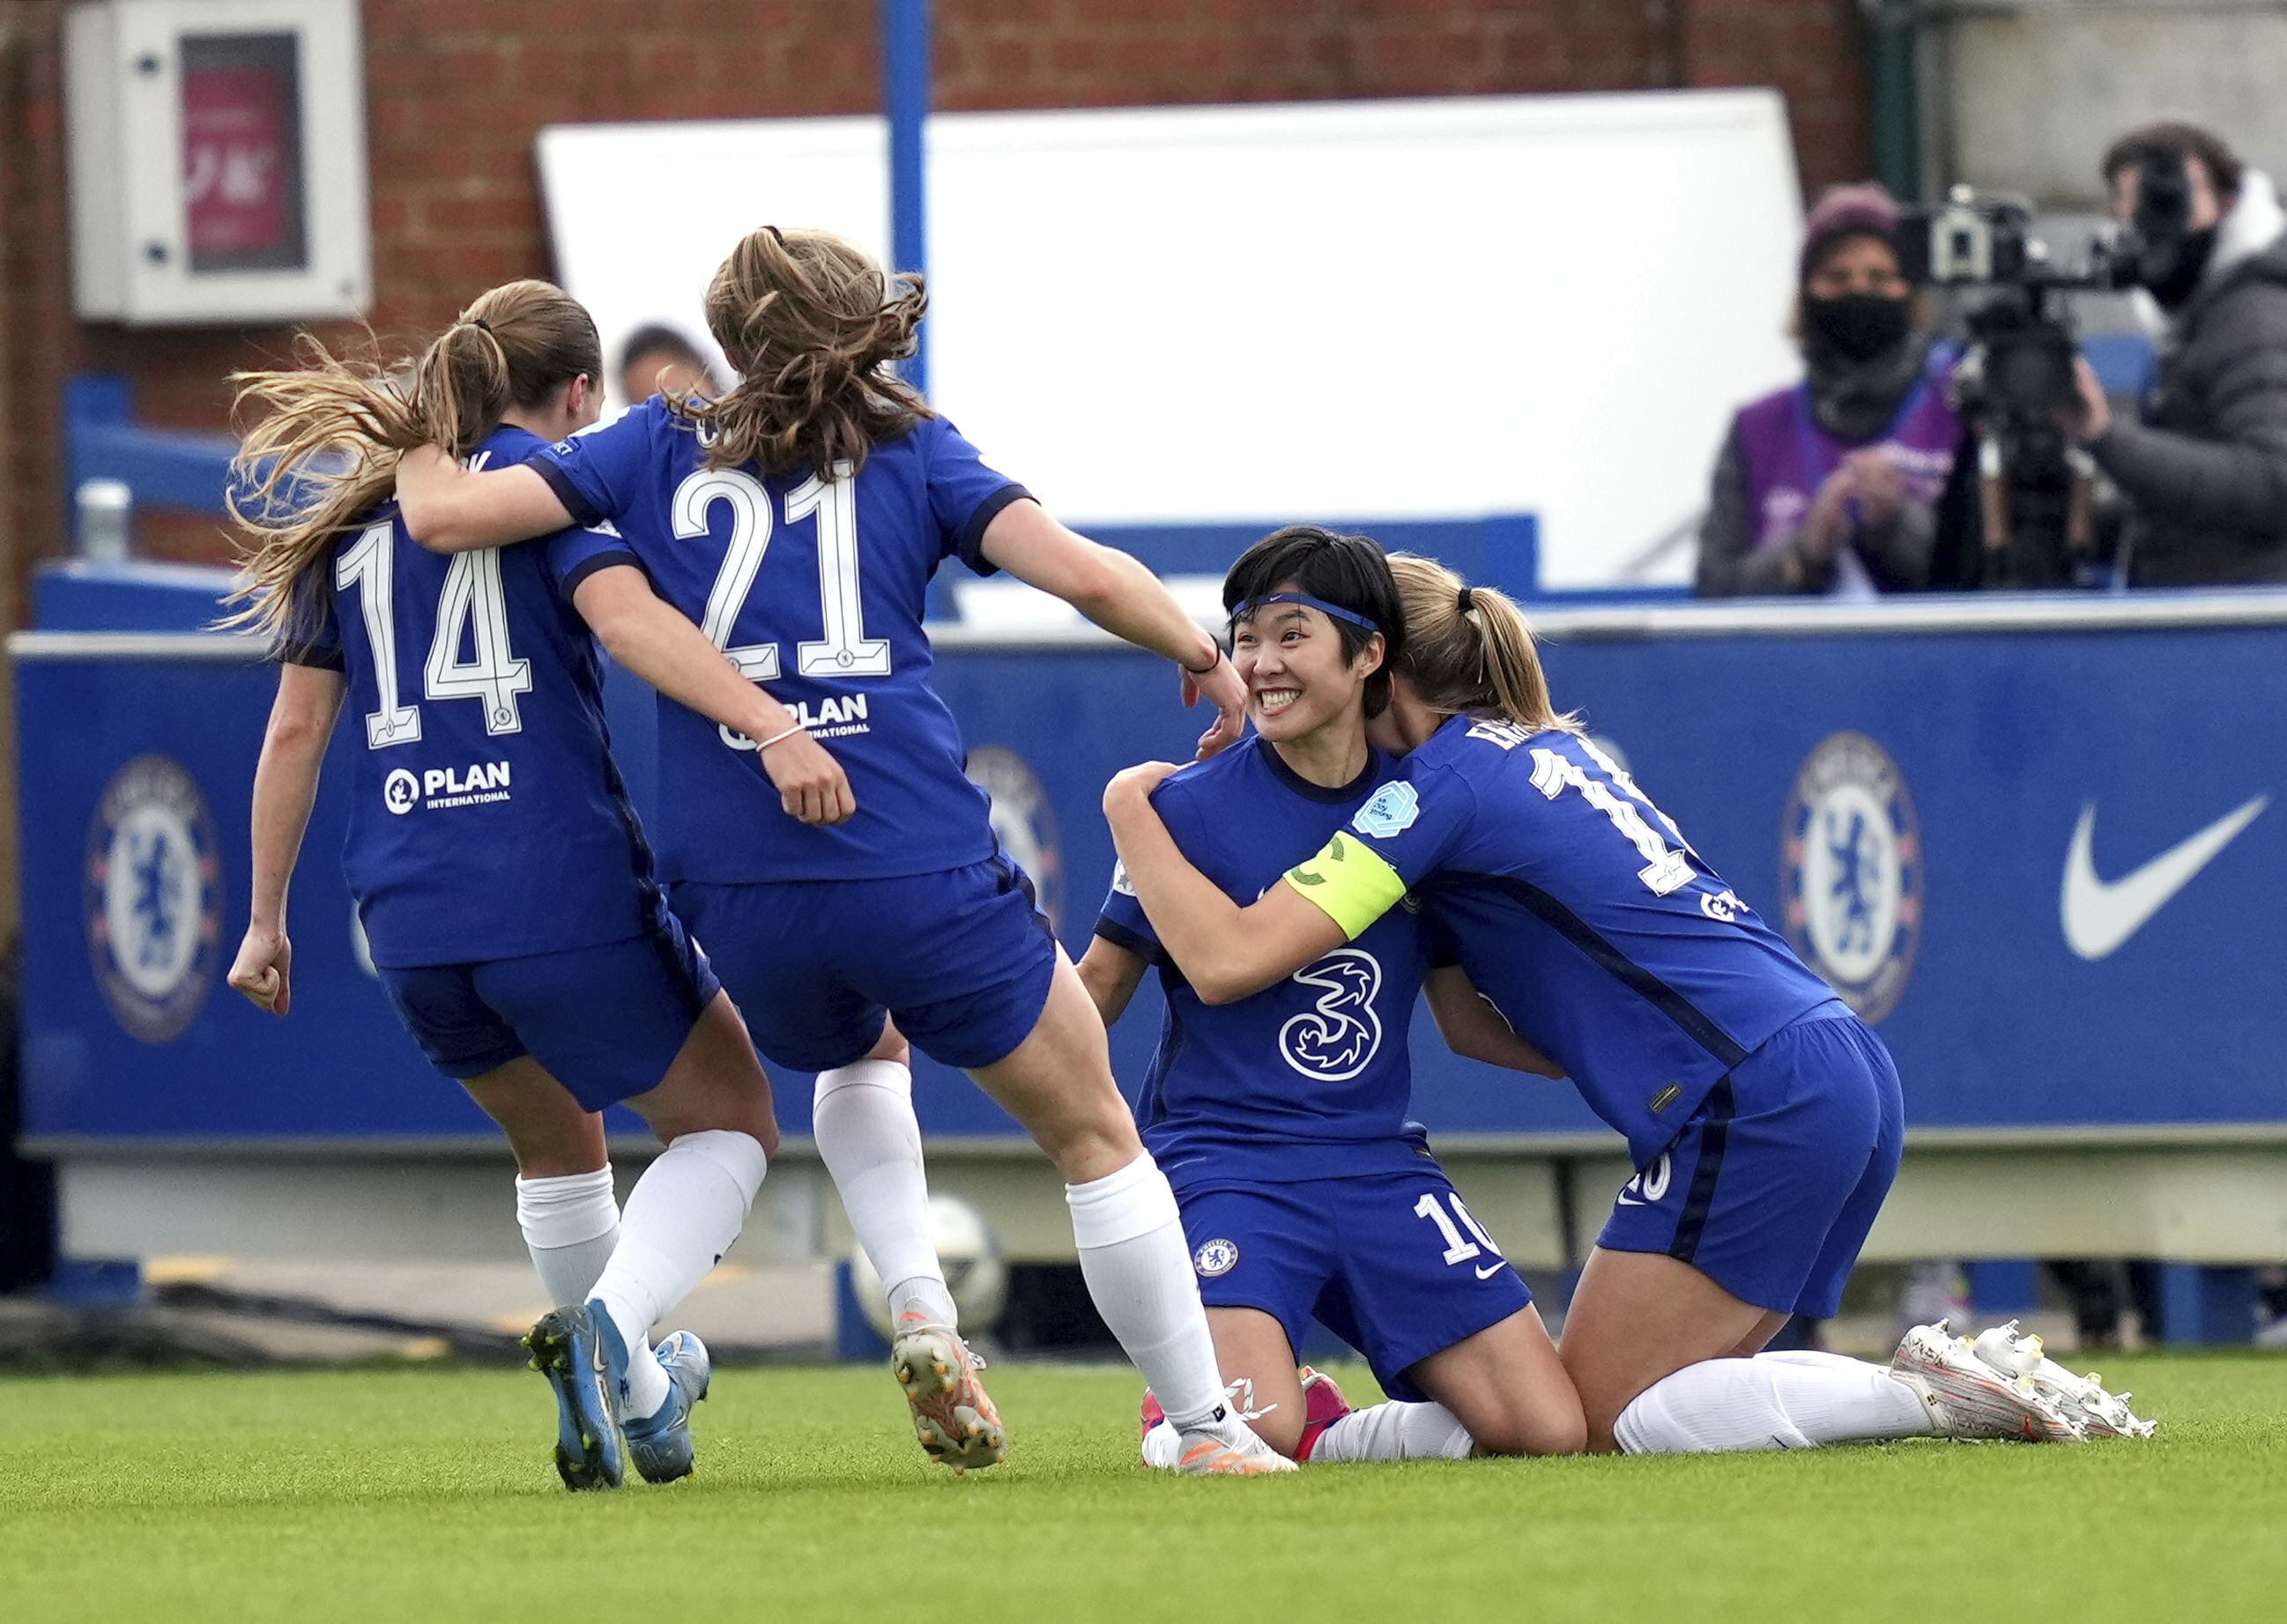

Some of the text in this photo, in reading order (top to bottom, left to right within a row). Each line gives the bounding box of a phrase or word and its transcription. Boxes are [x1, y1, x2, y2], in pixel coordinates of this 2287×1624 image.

[671, 458, 892, 682] 21
[335, 520, 532, 750] 14
[423, 760, 511, 797] PLAN
[427, 790, 511, 810] INTERNATIONAL
[1413, 1191, 1502, 1266] 10
